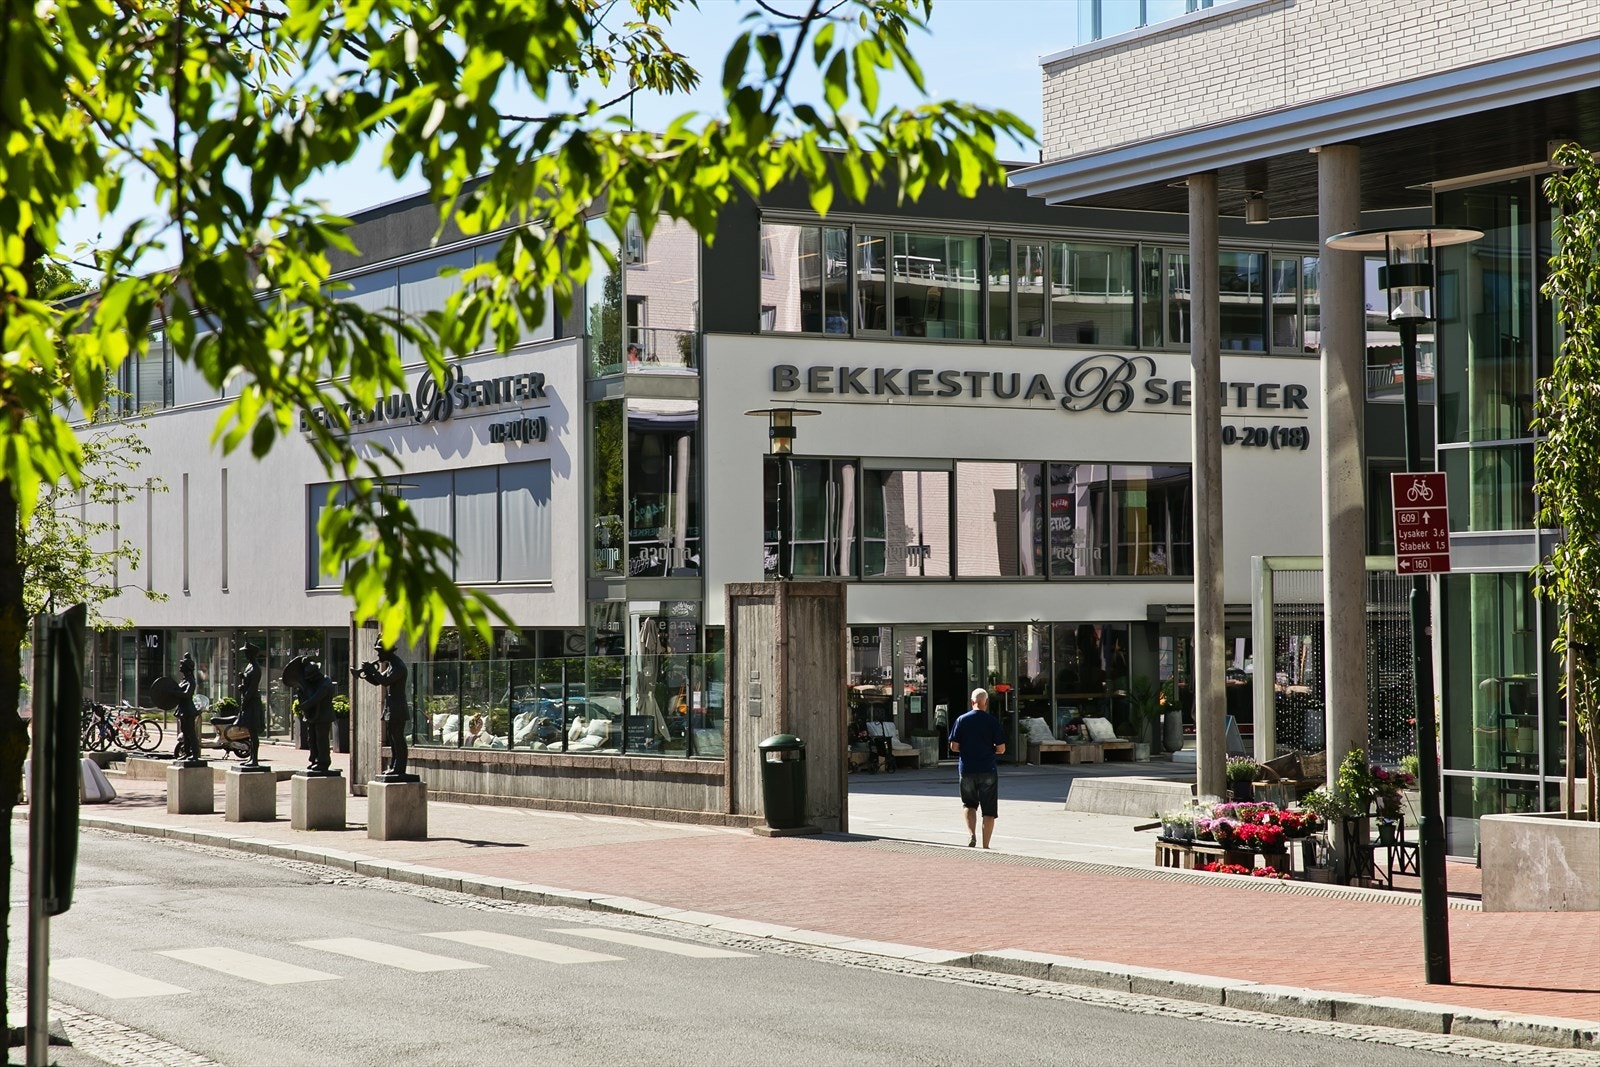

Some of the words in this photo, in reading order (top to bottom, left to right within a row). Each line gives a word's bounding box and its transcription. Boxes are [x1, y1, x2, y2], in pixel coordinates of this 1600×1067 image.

[772, 364, 1056, 400] BEKKESTUA
[453, 371, 547, 409] SENTER
[1220, 425, 1310, 450] 0-20(18)
[1401, 513, 1416, 523] 609
[1399, 529, 1428, 540] Lysaker
[1400, 541, 1431, 551] Stabekk
[1436, 541, 1446, 550] 1,5
[1415, 559, 1428, 569] 160
[145, 634, 159, 648] VIC
